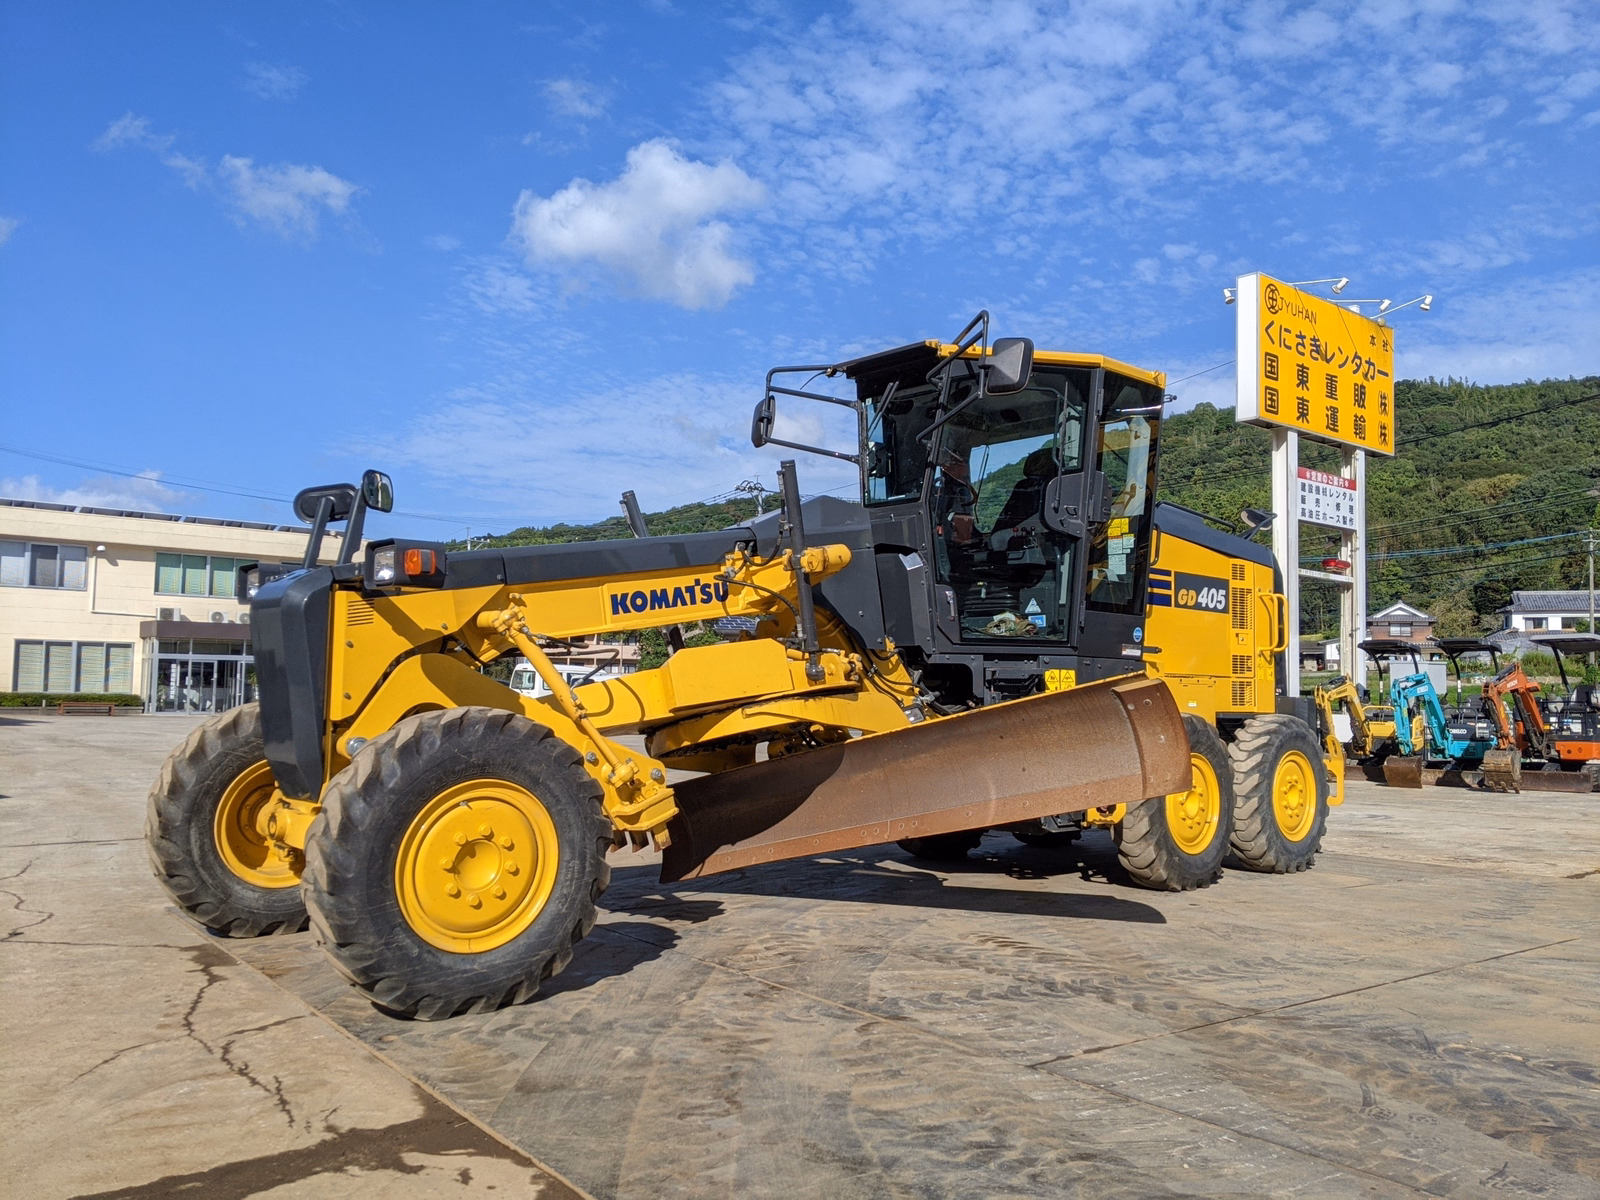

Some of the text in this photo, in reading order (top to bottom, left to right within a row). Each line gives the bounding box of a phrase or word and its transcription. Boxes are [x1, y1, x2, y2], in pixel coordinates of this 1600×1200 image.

[1278, 297, 1317, 325] JYUHAN
[1265, 320, 1389, 381] くにさきレンタカー
[1300, 482, 1354, 502] 建設機械レンタル
[1300, 507, 1354, 526] 高油圧ホース製作
[610, 579, 729, 615] KOMATSU
